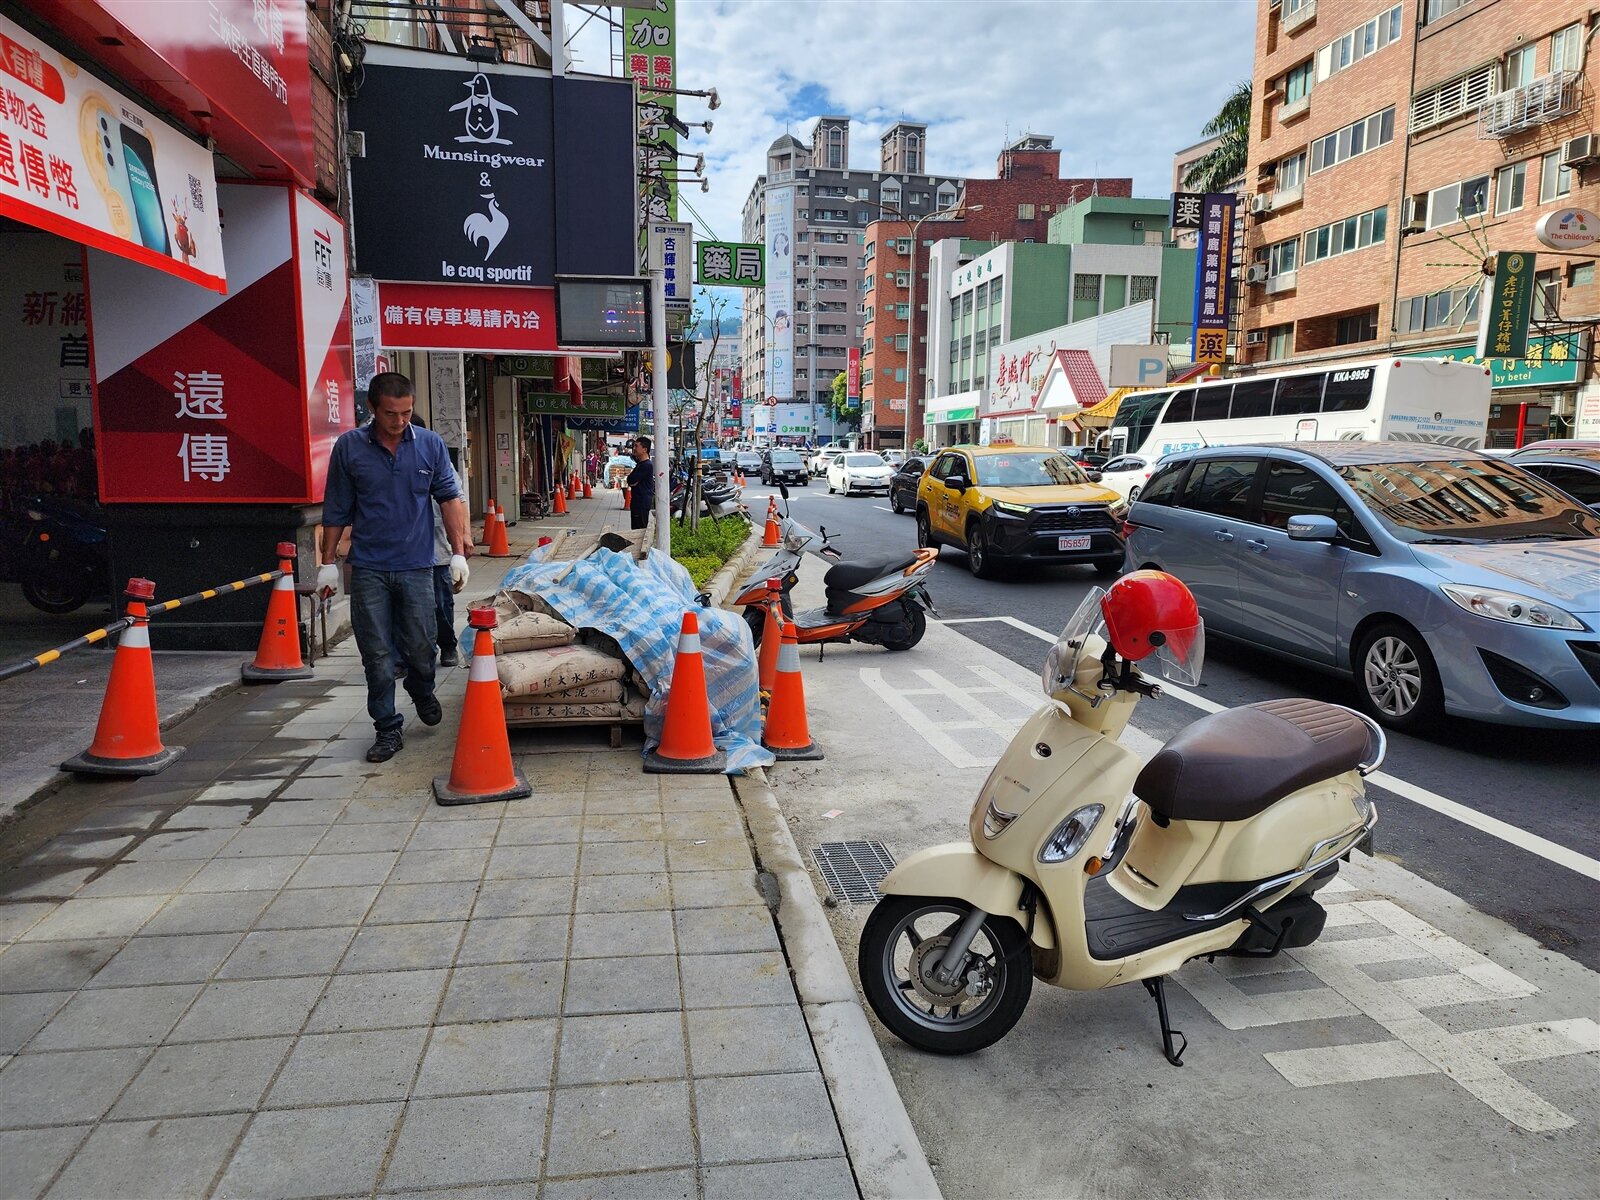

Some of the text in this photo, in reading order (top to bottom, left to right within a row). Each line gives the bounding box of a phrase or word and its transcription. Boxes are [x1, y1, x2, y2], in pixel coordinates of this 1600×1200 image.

[423, 144, 545, 168] Munsingwear
[480, 172, 491, 187] &
[442, 261, 532, 282] le coq sportif
[703, 246, 762, 282] 藥局
[1138, 358, 1164, 384] P
[1333, 369, 1370, 382] KKA-9956
[1495, 372, 1532, 382] by betel
[173, 370, 231, 482] 遠傳
